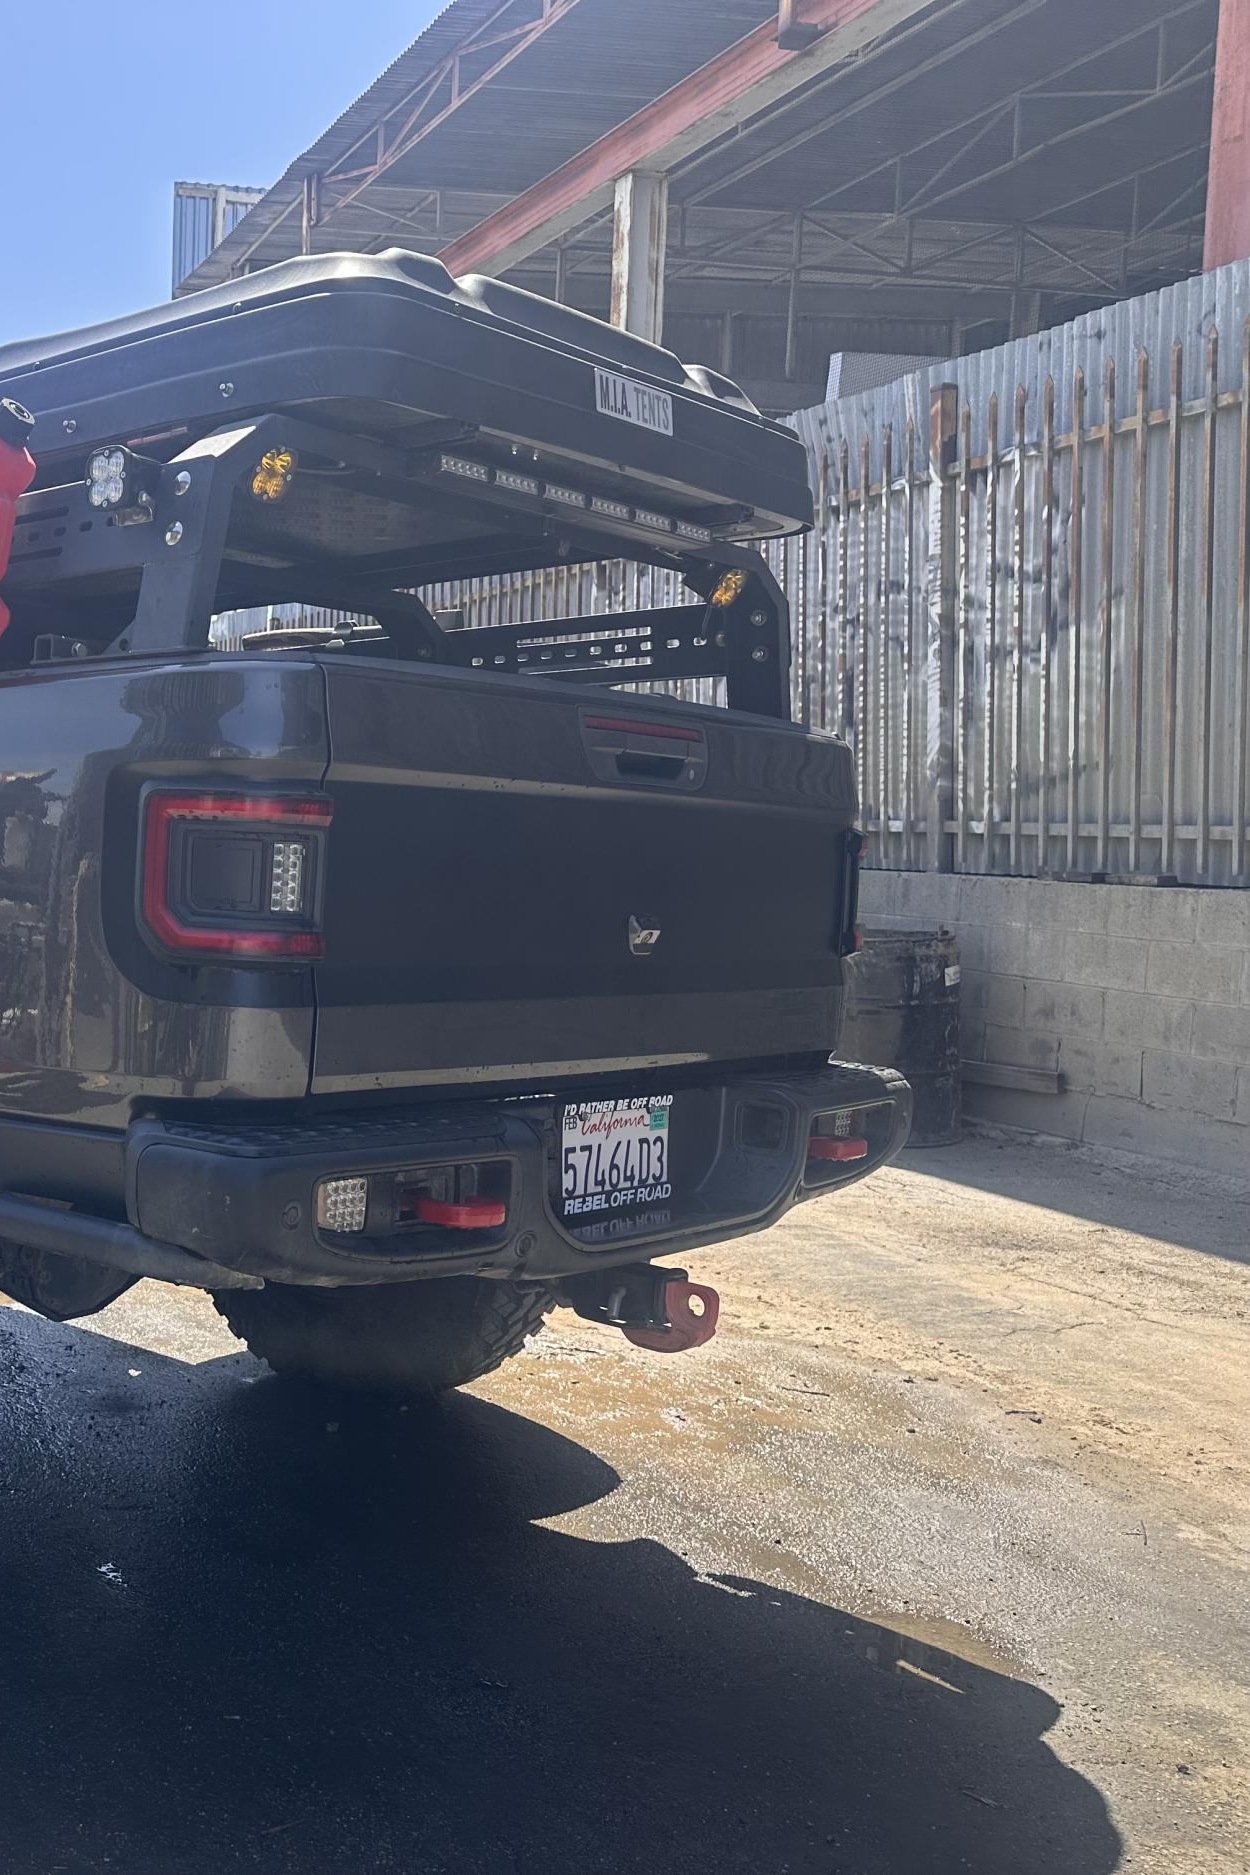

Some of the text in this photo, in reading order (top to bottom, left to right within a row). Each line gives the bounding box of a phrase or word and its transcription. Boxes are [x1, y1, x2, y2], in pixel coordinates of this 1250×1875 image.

[633, 386, 669, 430] TENTS
[564, 1105, 577, 1117] I'D
[579, 1101, 615, 1114] RATHER
[616, 1099, 630, 1111] BE
[630, 1097, 648, 1109] OFF
[649, 1095, 673, 1107] ROAD
[564, 1117, 578, 1131] FEB
[581, 1112, 650, 1139] California
[564, 1136, 664, 1197] 57464D3
[564, 1183, 672, 1216] REBEL OFF ROAD
